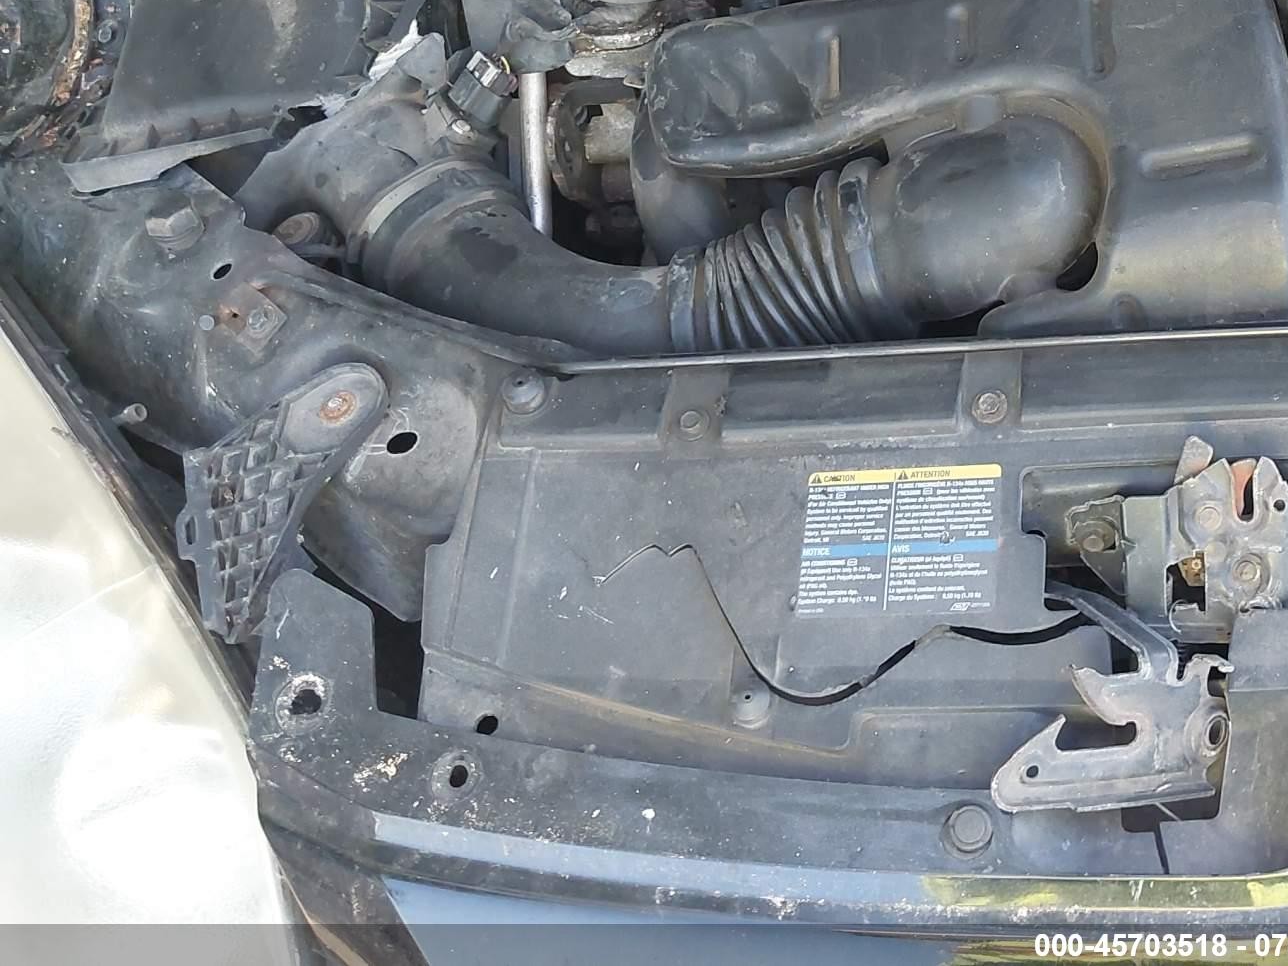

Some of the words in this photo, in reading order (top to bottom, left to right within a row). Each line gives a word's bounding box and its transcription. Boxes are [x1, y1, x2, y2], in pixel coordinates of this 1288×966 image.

[910, 470, 950, 478] ATTENTION
[802, 548, 830, 556] NOTICE
[892, 545, 910, 553] AVIS
